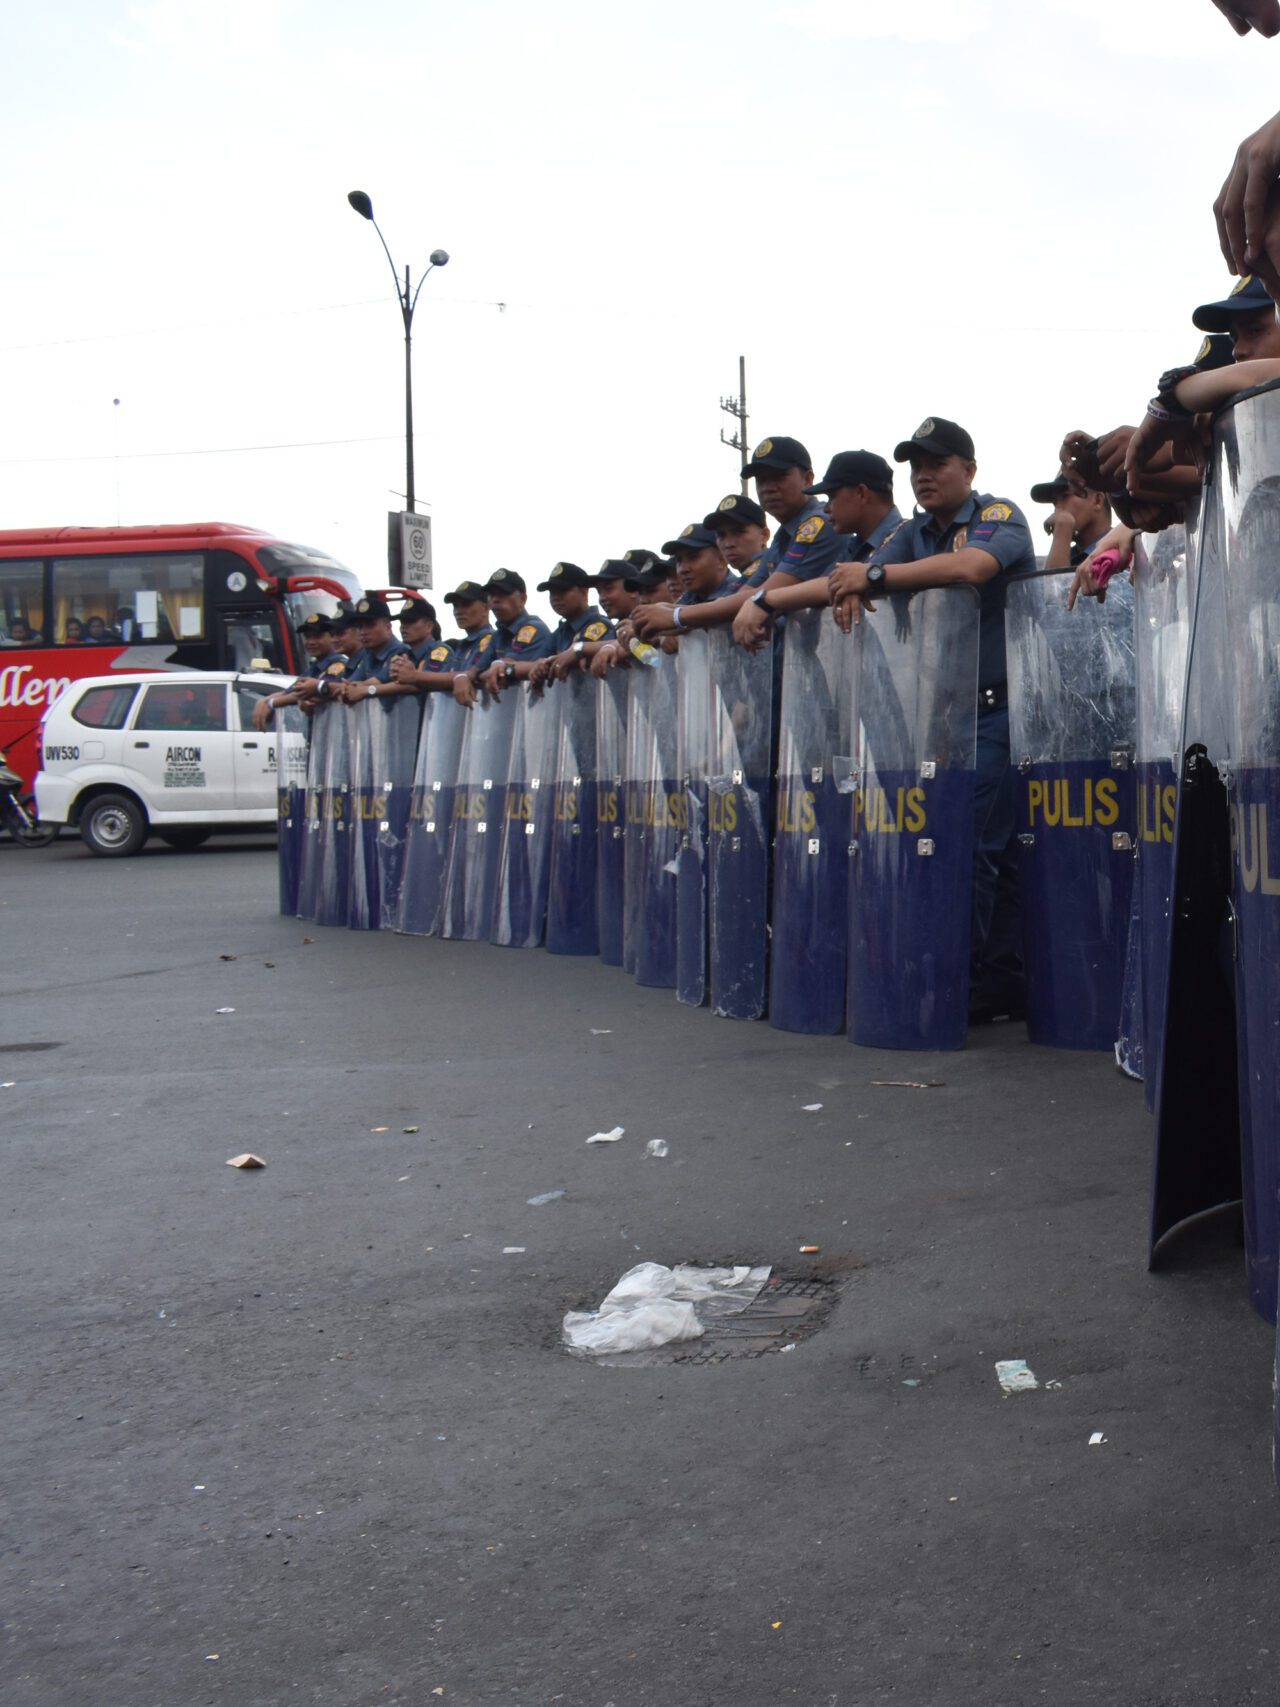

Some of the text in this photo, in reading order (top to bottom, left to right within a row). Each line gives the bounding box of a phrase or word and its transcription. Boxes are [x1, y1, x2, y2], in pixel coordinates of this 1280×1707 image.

[407, 561, 430, 574] SPEED
[410, 572, 428, 583] LIMIT
[166, 746, 202, 762] AIRCON
[507, 792, 534, 820] LIS
[556, 791, 577, 821] LIS
[598, 791, 617, 822] LIS
[854, 786, 926, 833] PULIS
[1029, 778, 1119, 828] PULIS
